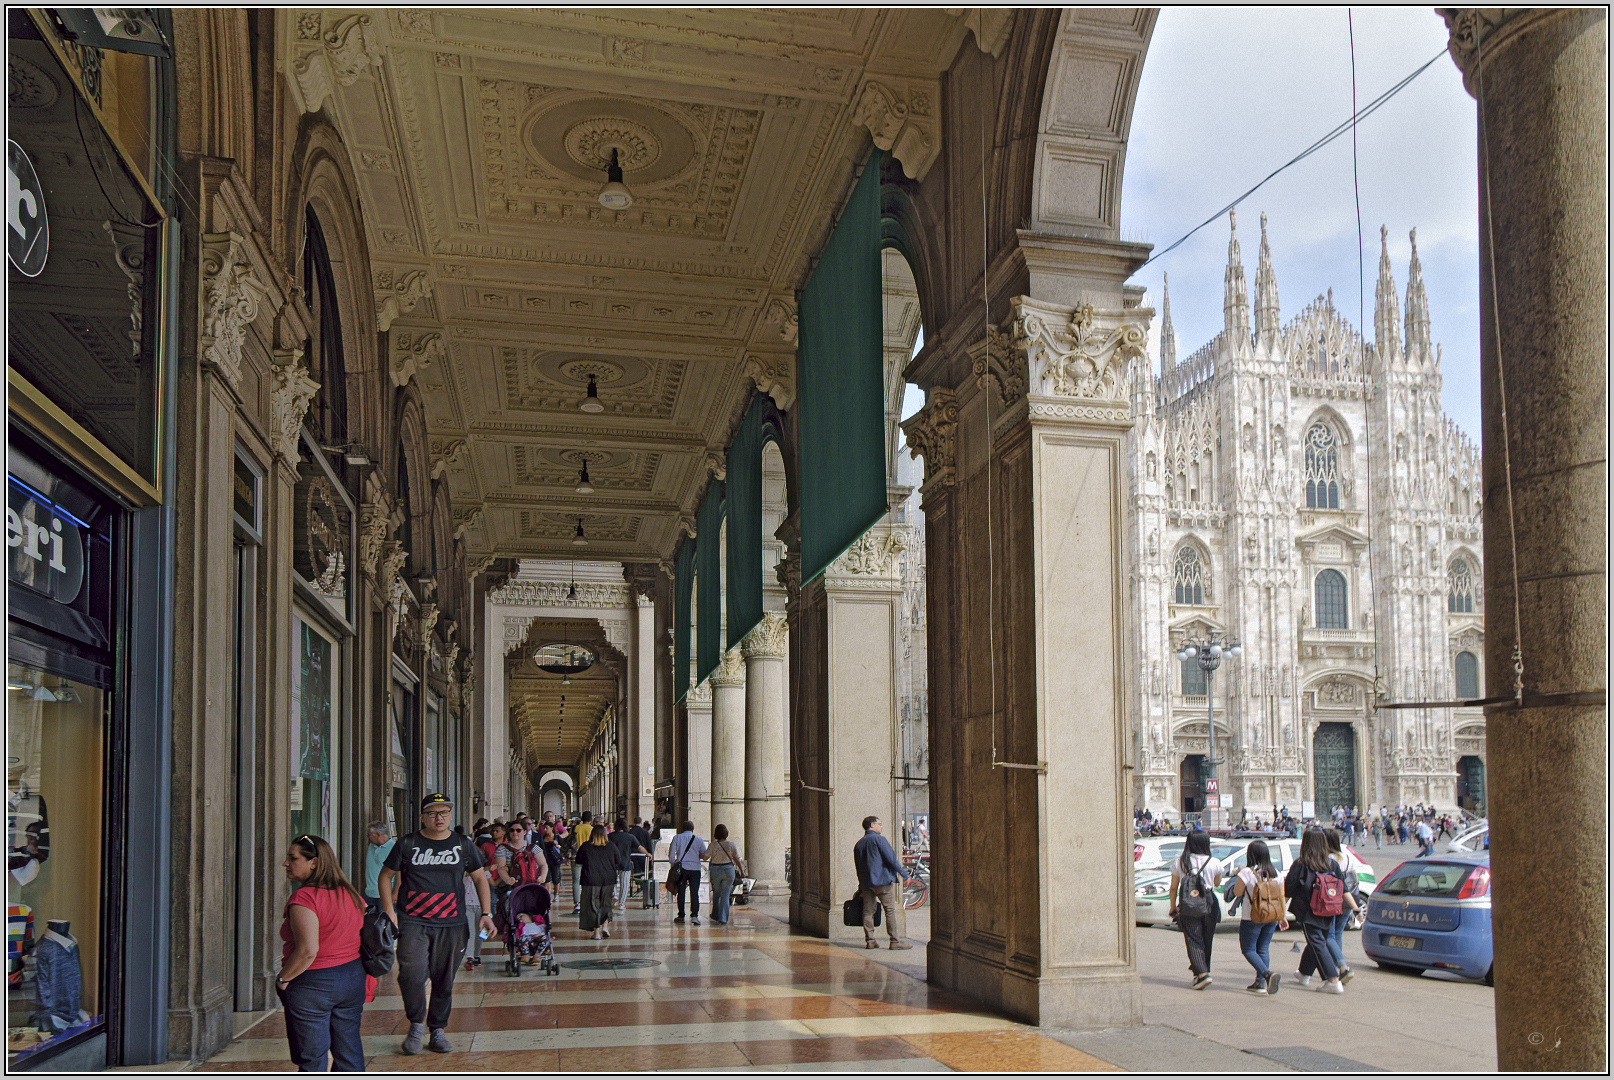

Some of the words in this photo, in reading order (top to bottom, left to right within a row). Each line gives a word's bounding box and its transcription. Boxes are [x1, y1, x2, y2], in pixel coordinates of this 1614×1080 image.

[8, 506, 66, 574] eri
[1207, 781, 1218, 790] M
[1381, 909, 1429, 923] POLIZIA
